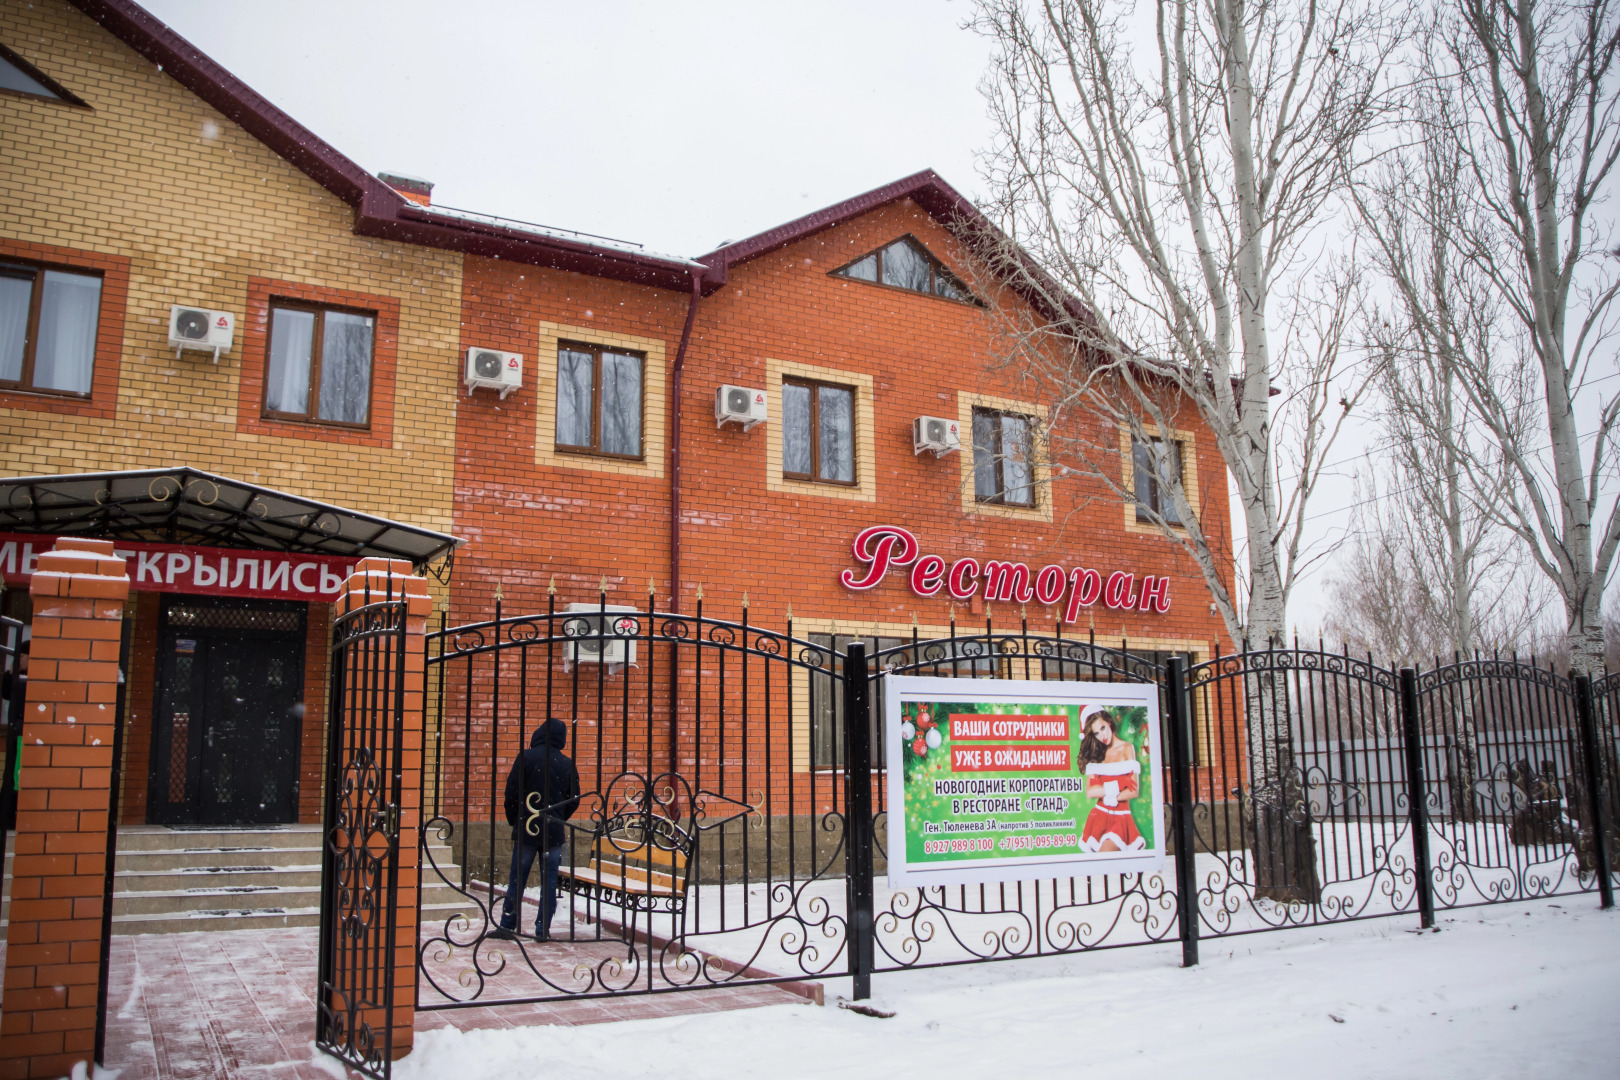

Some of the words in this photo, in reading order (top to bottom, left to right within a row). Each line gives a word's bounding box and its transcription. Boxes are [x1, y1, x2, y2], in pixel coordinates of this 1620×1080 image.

[838, 525, 1171, 623] Ресторан
[954, 720, 990, 737] ВАШИ
[993, 720, 1065, 739] СОТРУДНИКИ
[955, 750, 982, 767] УЖЕ
[984, 750, 992, 766] В
[994, 750, 1067, 769] ОЖИДАНИИ?
[935, 779, 1006, 796] НОВОГОДНИЕ
[1009, 778, 1082, 793] КОРПОРАТИВЫ
[953, 800, 960, 814] В
[963, 798, 1021, 813] РЕСТОРАНЕ
[1025, 797, 1069, 814] «ГРАНД»
[924, 822, 942, 833] Ген.
[943, 820, 985, 832] Тюленева
[998, 820, 1029, 832] (напротив
[1030, 820, 1034, 829] 5
[1034, 818, 1075, 829] поликлиники)
[924, 842, 931, 853] 8
[932, 841, 950, 853] 927
[951, 840, 968, 851] 989
[969, 839, 975, 851] 8
[977, 838, 993, 850] 100
